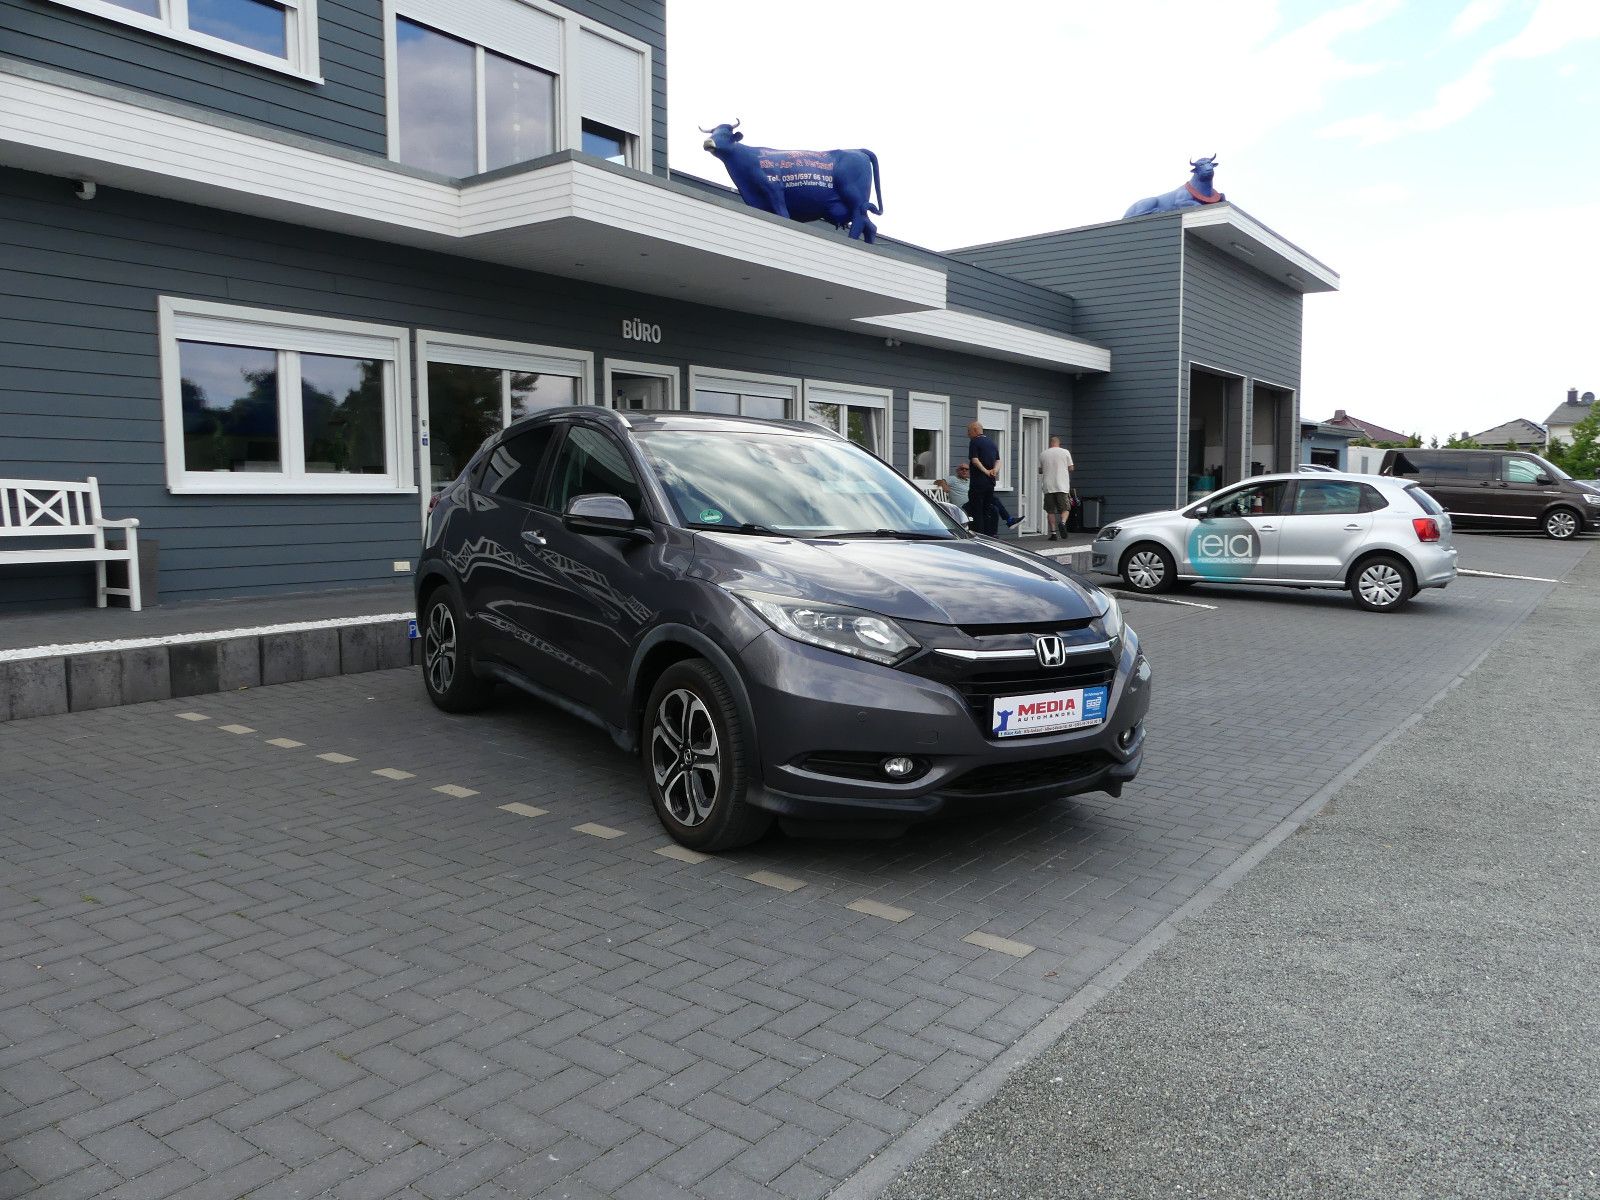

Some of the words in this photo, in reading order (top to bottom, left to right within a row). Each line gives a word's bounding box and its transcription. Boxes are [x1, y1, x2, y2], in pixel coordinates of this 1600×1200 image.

[822, 175, 833, 183] 100
[622, 317, 662, 343] BÜRO
[1018, 698, 1075, 716] MEDIA
[1018, 712, 1075, 722] AUTOHANDEL
